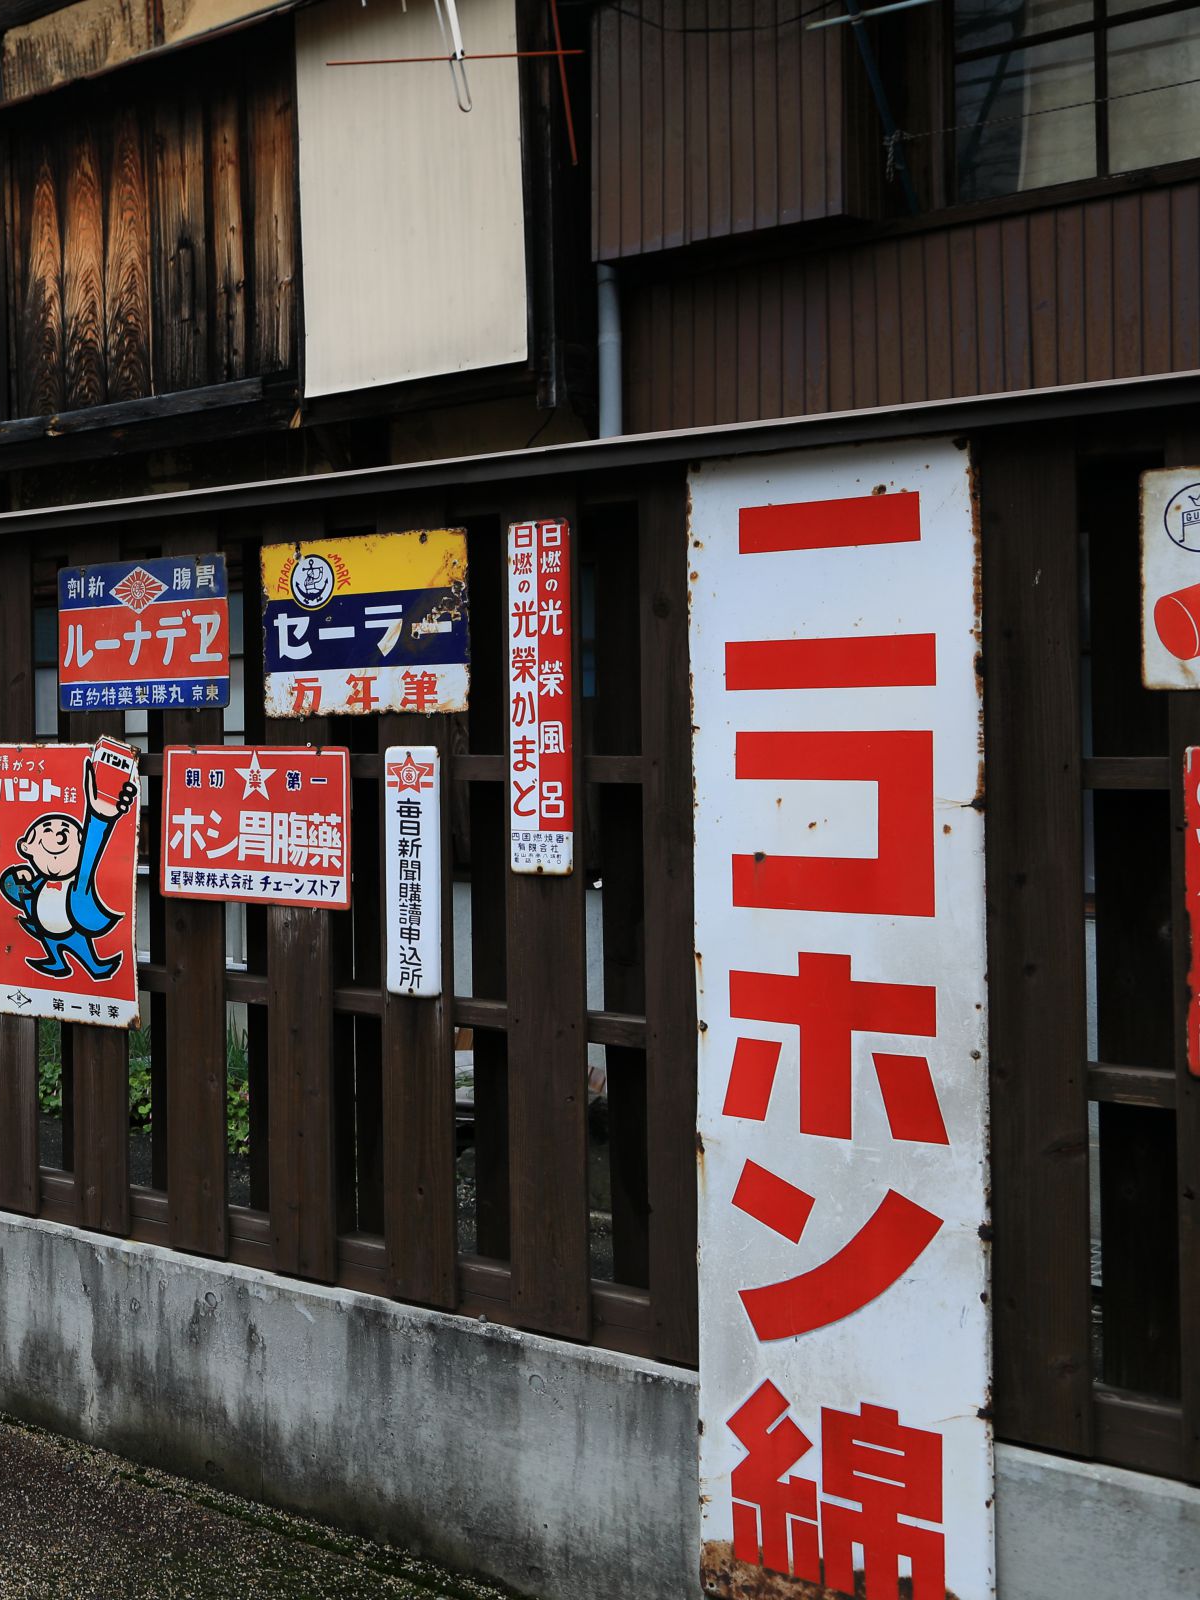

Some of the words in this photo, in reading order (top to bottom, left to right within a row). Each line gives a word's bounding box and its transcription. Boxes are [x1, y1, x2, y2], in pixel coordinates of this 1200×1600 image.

[277, 557, 295, 595] TRADE
[328, 553, 351, 591] MARK
[273, 604, 453, 660] セーラー
[291, 670, 438, 713] 万年筆
[100, 750, 130, 770] パント
[185, 768, 225, 788] 親切
[286, 771, 328, 791] 第一
[259, 875, 341, 898] チェーンストア
[722, 491, 950, 1600] ニコホン綿
